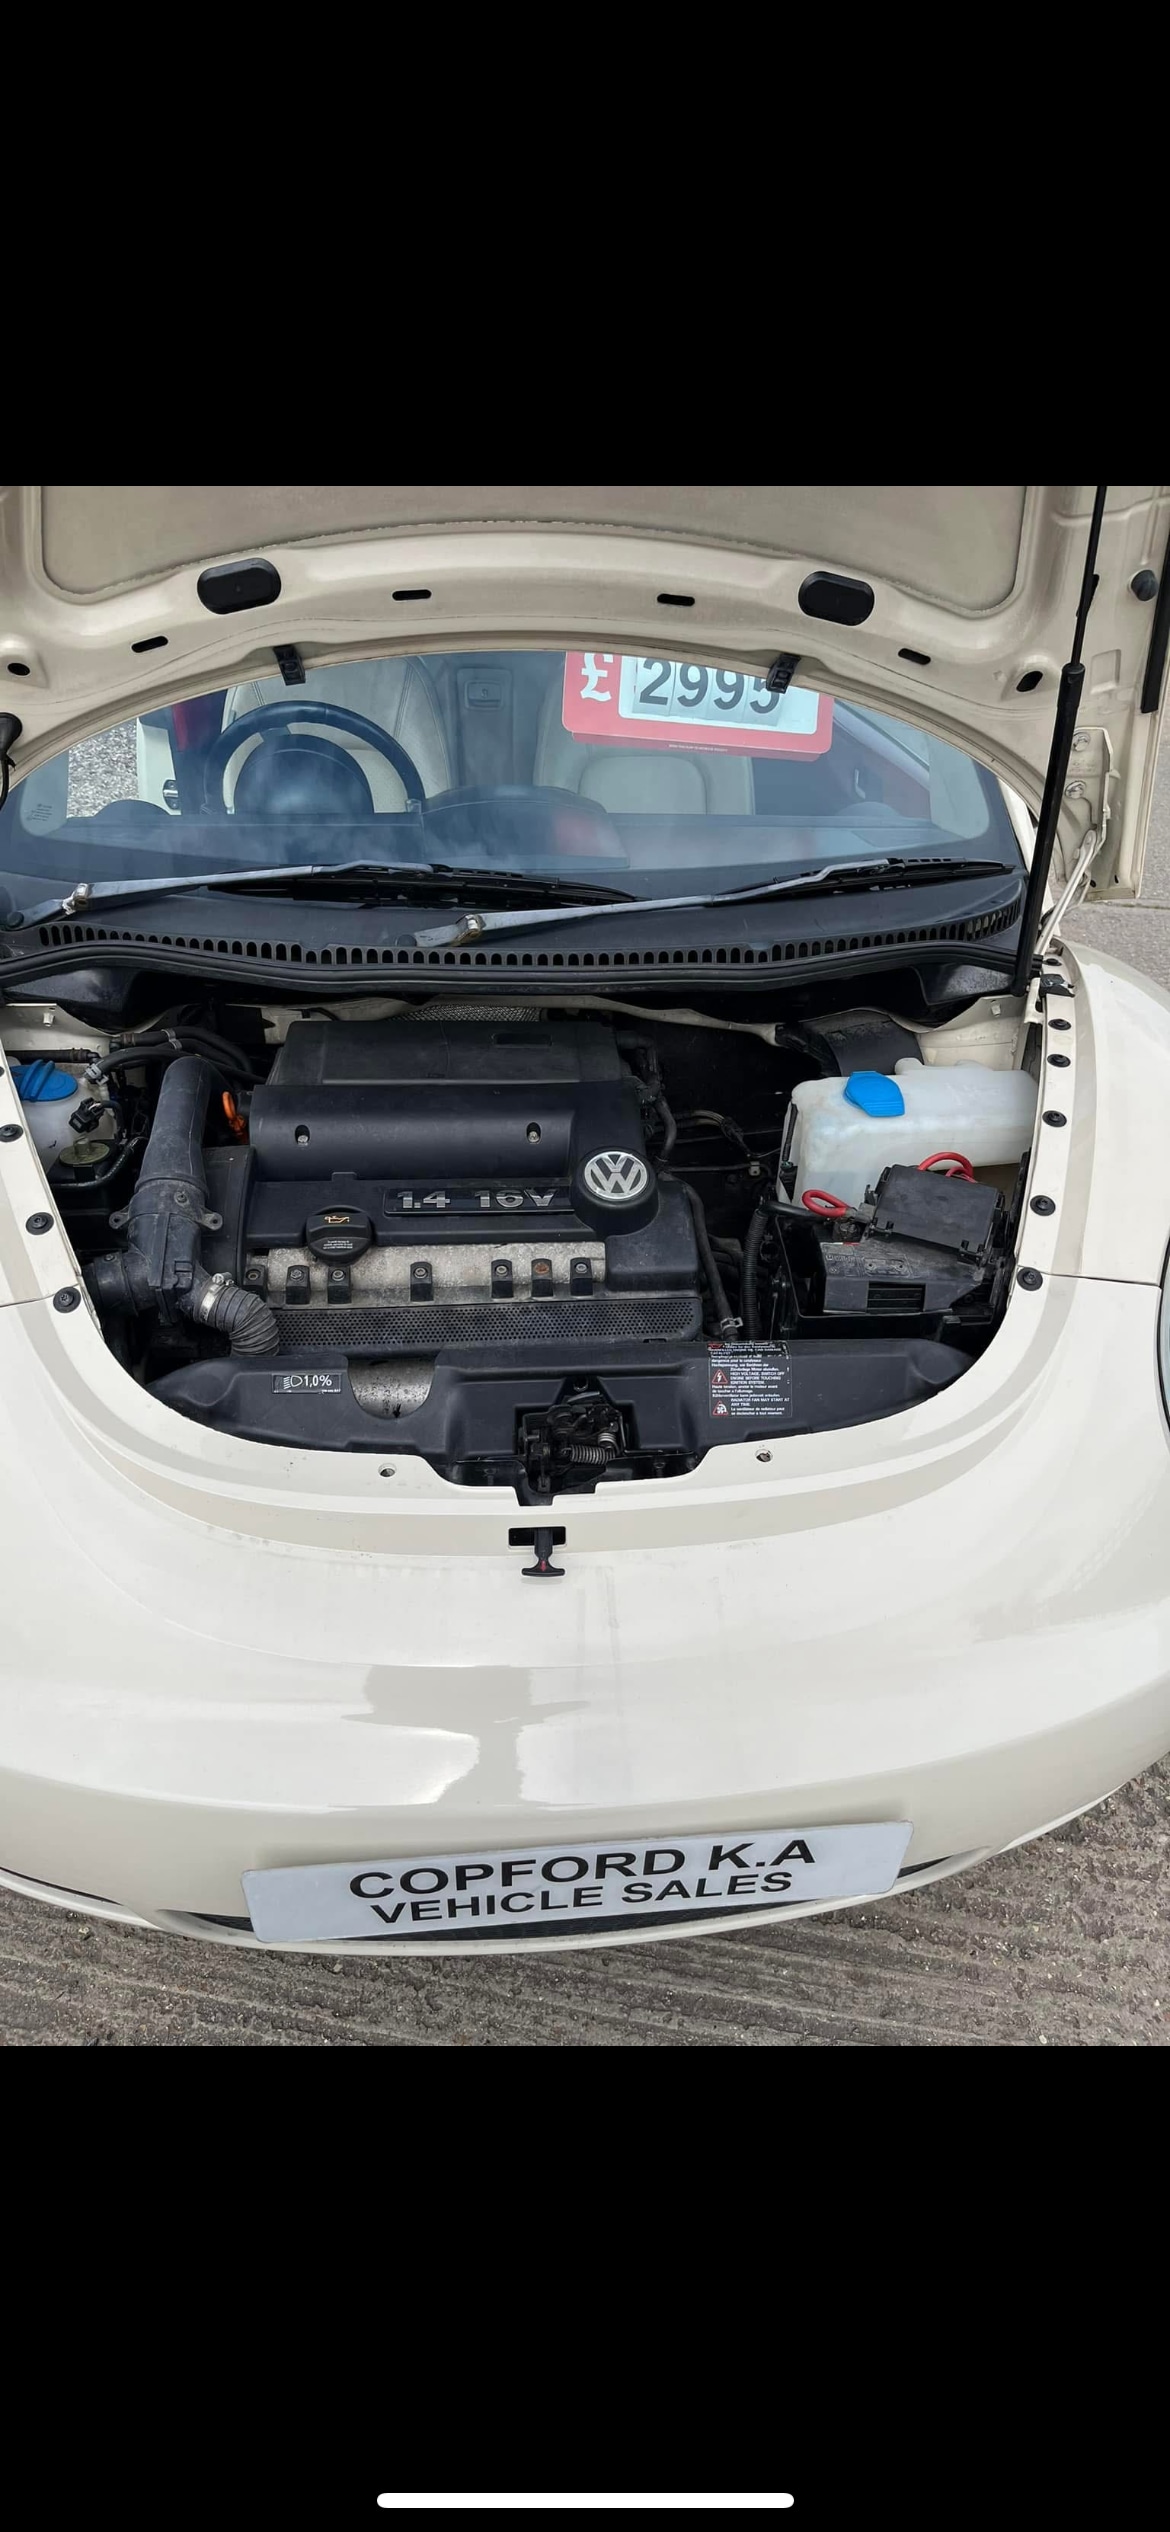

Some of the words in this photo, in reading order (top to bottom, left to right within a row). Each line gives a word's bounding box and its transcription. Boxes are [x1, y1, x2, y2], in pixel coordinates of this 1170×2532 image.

[638, 658, 783, 714] 2995
[397, 1190, 451, 1209] 1.4
[473, 1187, 557, 1209] 16V
[585, 1151, 649, 1201] VW
[304, 1374, 333, 1389] 1,0%
[350, 1849, 686, 1899] COPFORD
[708, 1839, 816, 1871] K.A
[370, 1886, 604, 1924] VEHICLE
[621, 1871, 793, 1904] SALES
